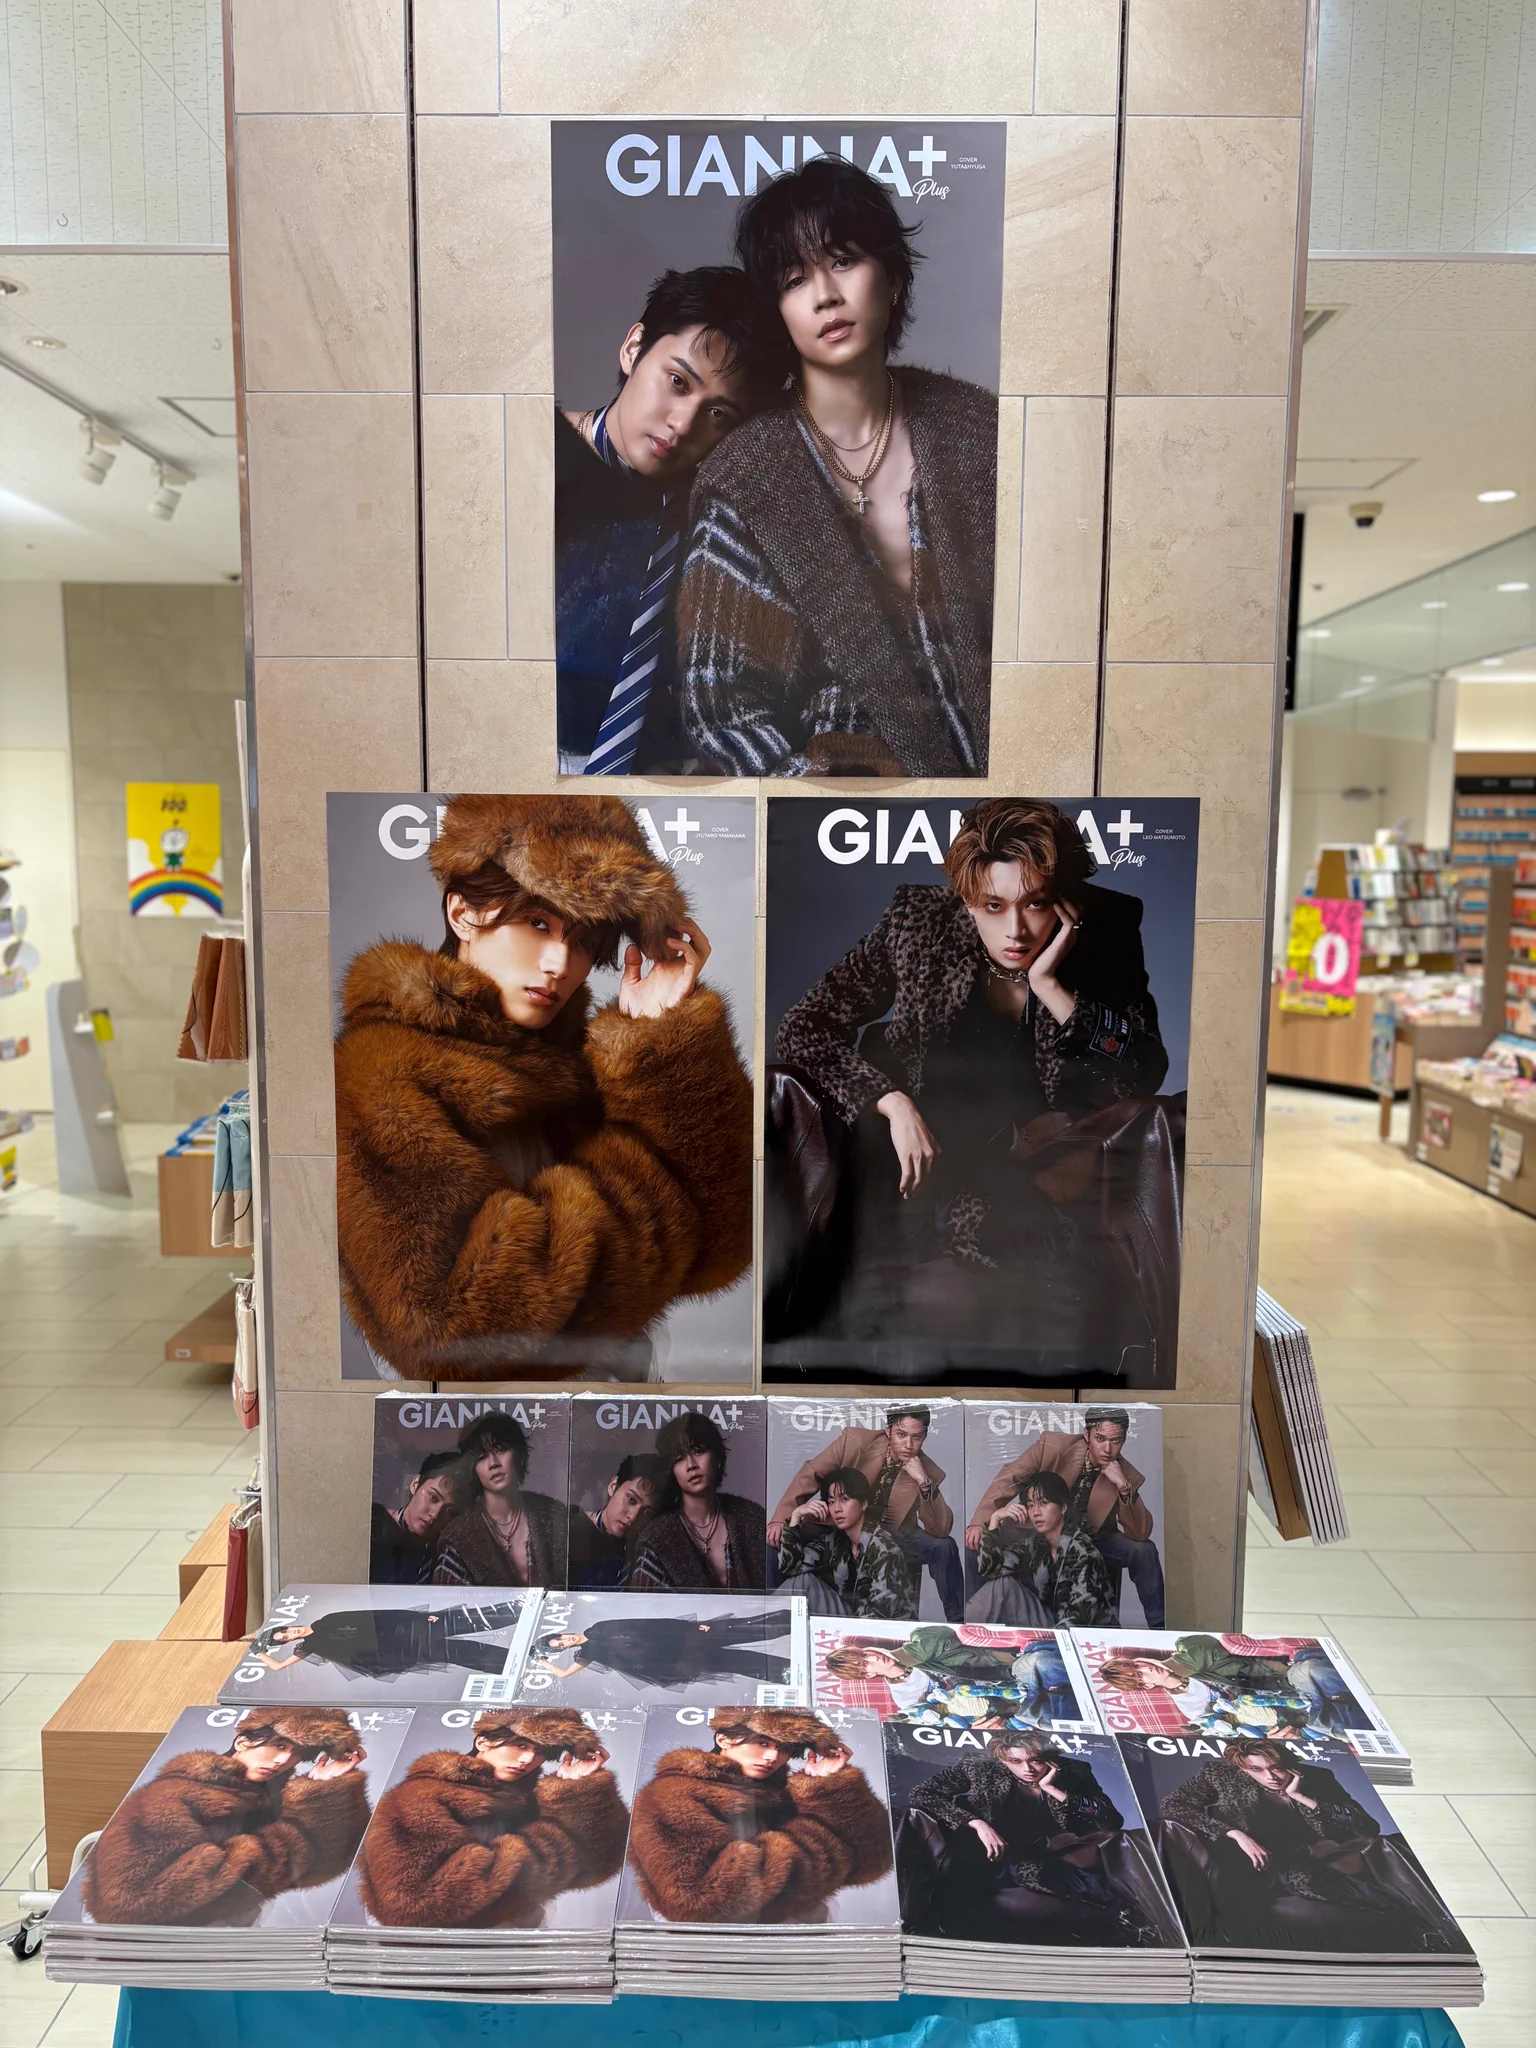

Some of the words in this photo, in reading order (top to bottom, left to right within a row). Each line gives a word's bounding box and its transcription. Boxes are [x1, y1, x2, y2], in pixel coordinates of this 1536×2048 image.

[912, 178, 951, 204] Plus
[817, 808, 1144, 865] GIAA+
[668, 845, 704, 869] Plus
[1110, 847, 1148, 871] Plus
[912, 1726, 1088, 1754] GIAA+
[1146, 1736, 1324, 1761] GIAA+
